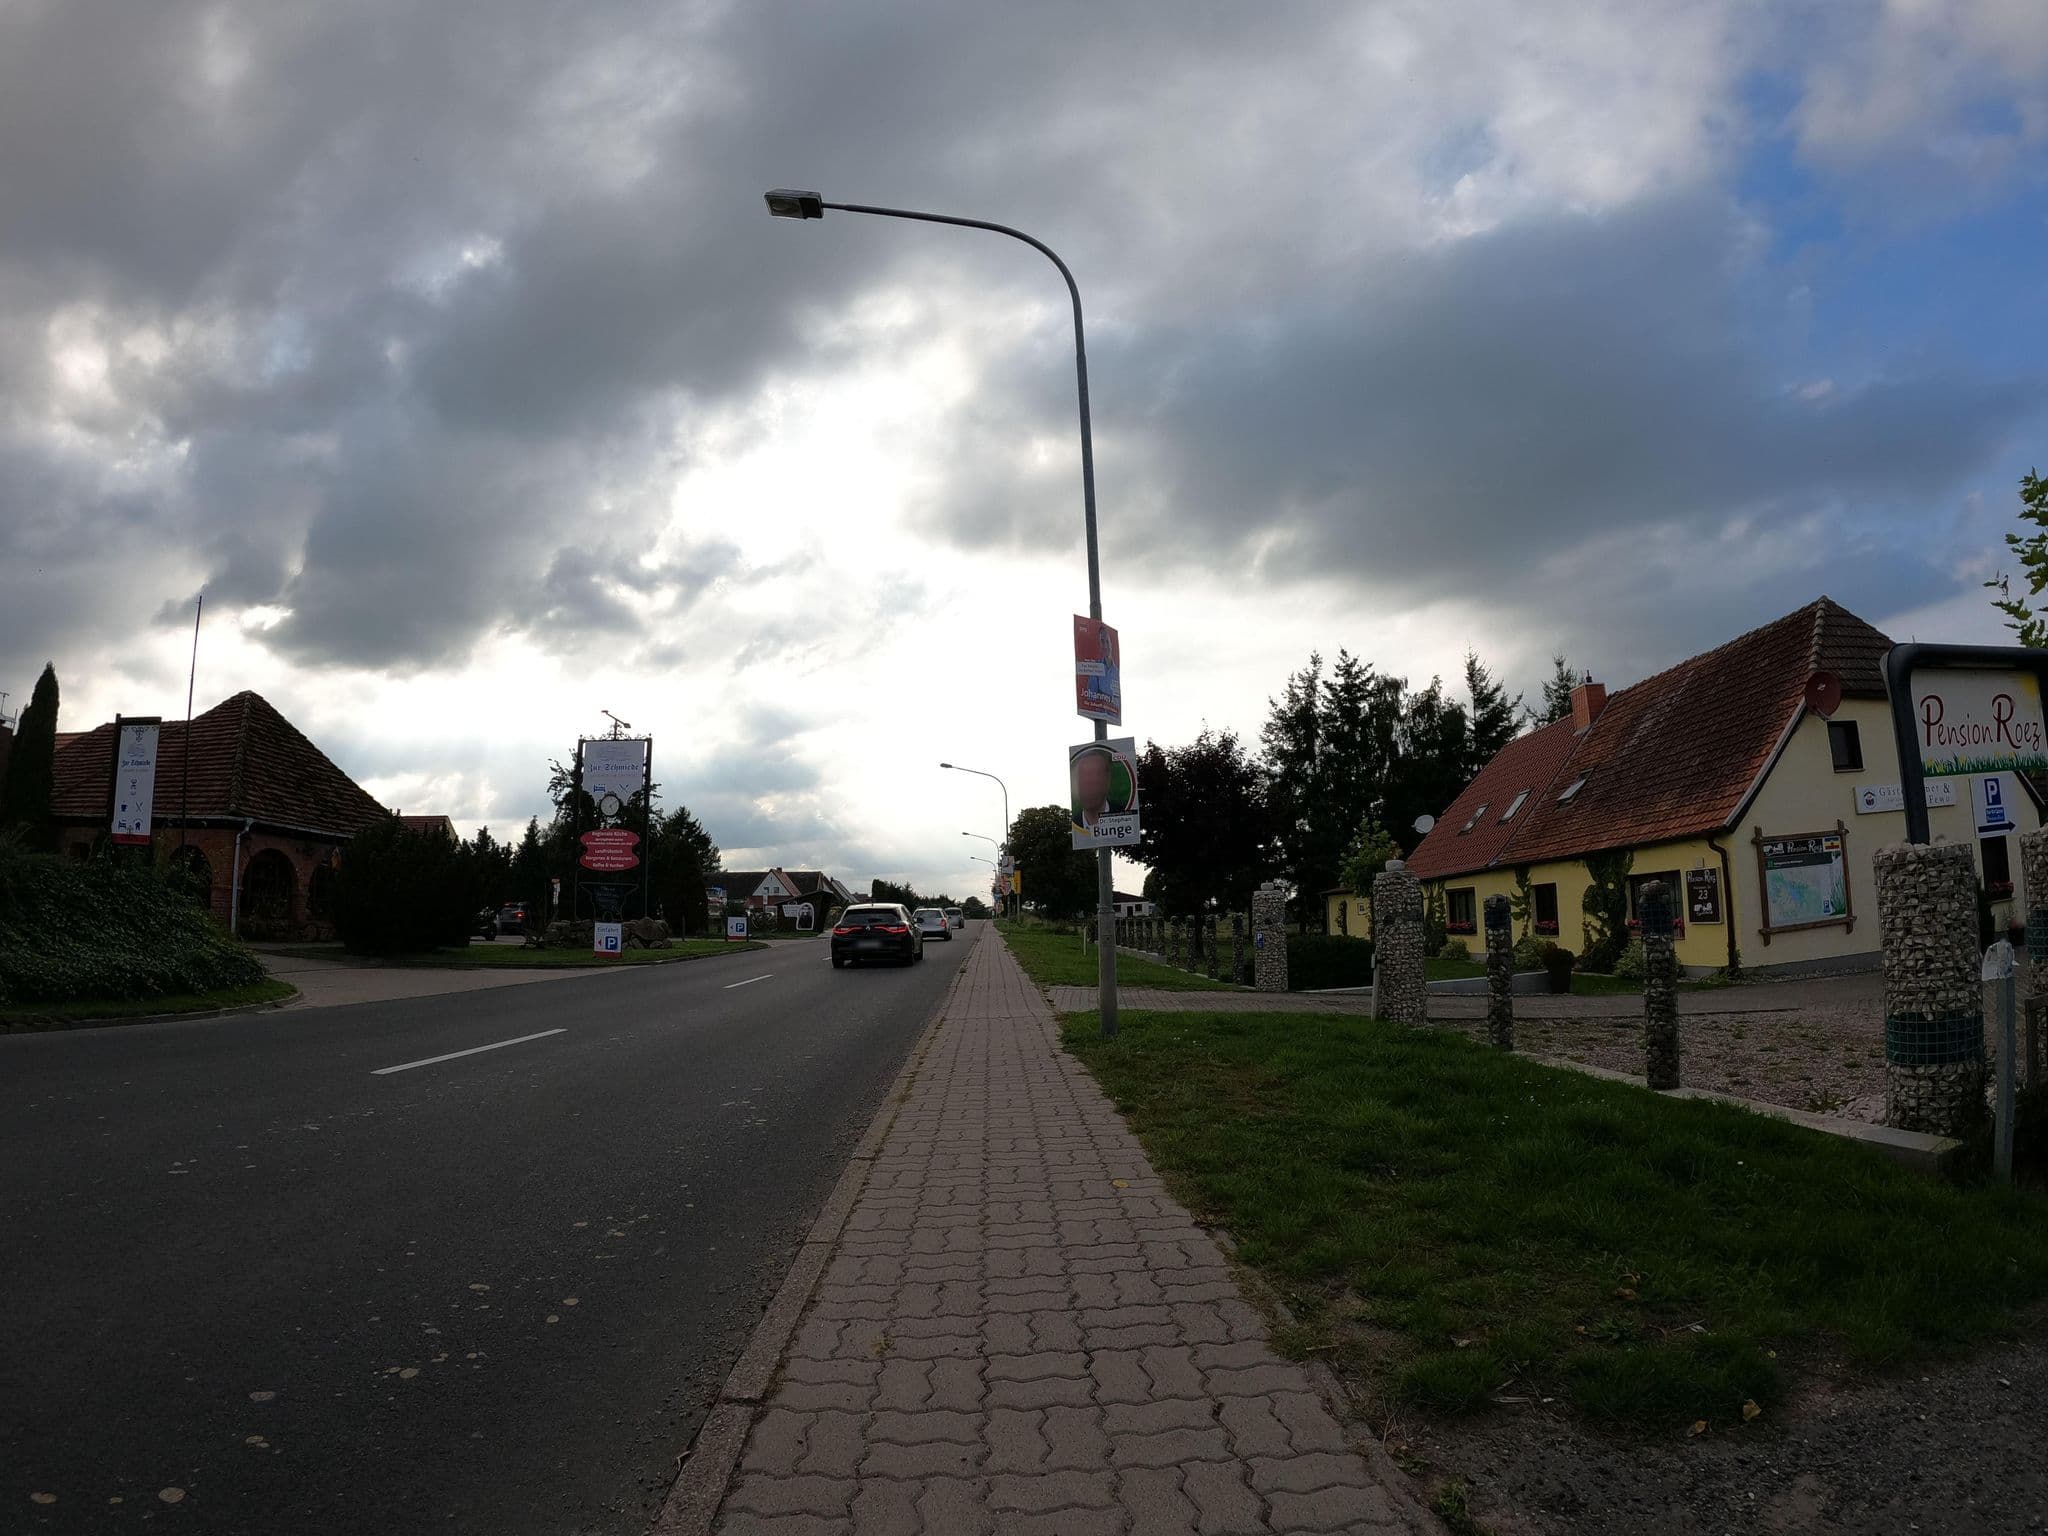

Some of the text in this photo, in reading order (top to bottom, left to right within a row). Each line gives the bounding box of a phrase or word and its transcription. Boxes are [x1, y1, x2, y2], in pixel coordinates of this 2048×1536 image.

[1080, 688, 1111, 703] Johannes
[1920, 693, 2042, 752] Pension Roez
[605, 763, 639, 773] Schmiede
[1943, 782, 1951, 794] &
[1986, 780, 1998, 804] P
[1109, 816, 1132, 824] Stephan
[1093, 824, 1132, 838] Bunge
[1697, 889, 1709, 900] 23
